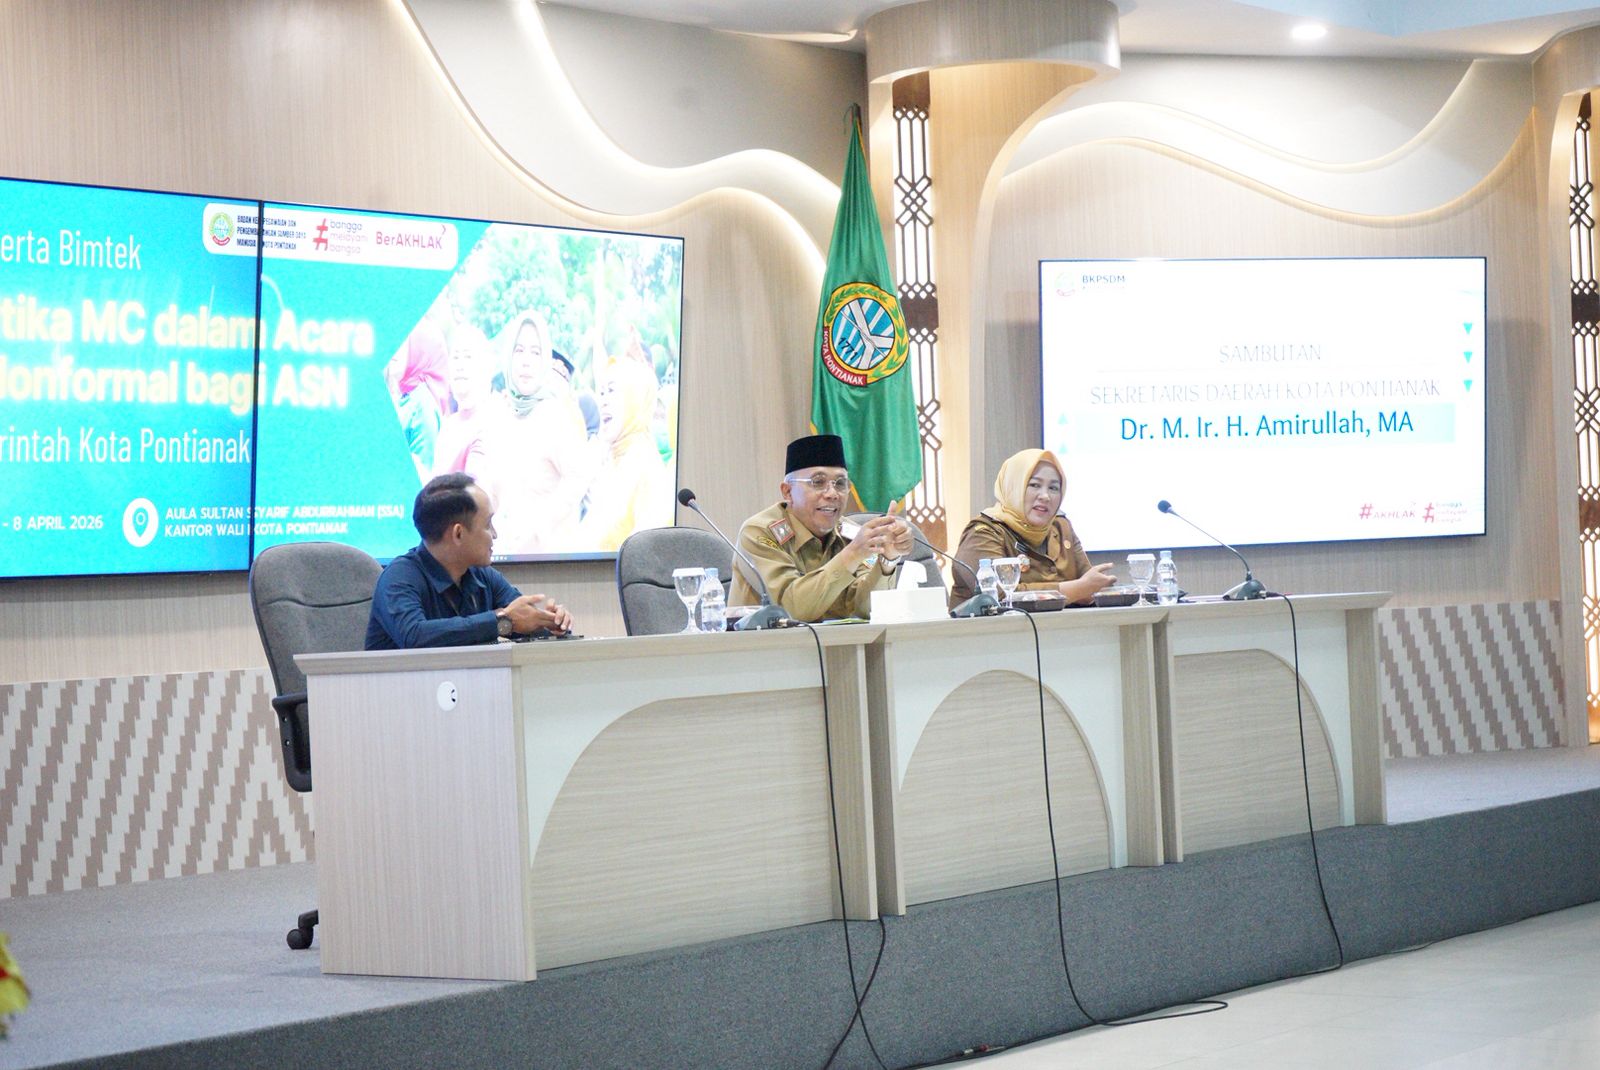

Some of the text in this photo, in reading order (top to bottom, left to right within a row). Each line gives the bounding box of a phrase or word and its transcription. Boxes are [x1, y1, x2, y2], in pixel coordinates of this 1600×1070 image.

[330, 220, 363, 233] bangga
[59, 228, 142, 270] Bimtek
[375, 231, 443, 249] BerAKHLAK
[1082, 274, 1126, 284] BKPSDM
[81, 298, 146, 345] MC
[153, 303, 266, 349] dalam
[272, 308, 374, 357] Acara
[838, 337, 858, 361] 1771
[1219, 343, 1322, 364] SAMBUTAN
[824, 354, 863, 385] PONTIANAK
[186, 360, 266, 416] bagi
[271, 363, 349, 409] ASN
[1090, 379, 1441, 405] SEKRETARIS DAERAH KOTA PONTIANAK
[1121, 410, 1414, 441] Dr. M. Ir. H. Amirullah, MA
[79, 427, 131, 464] Kota
[140, 427, 250, 464] Pontianak
[13, 515, 22, 531] 8
[26, 515, 66, 531] APRIL
[69, 514, 104, 530] 2026
[165, 507, 197, 520] AULA
[200, 506, 244, 519] SULTAN
[164, 523, 212, 537] KANTOR
[216, 523, 244, 536] WALI
[286, 522, 349, 535] PONTIANAK
